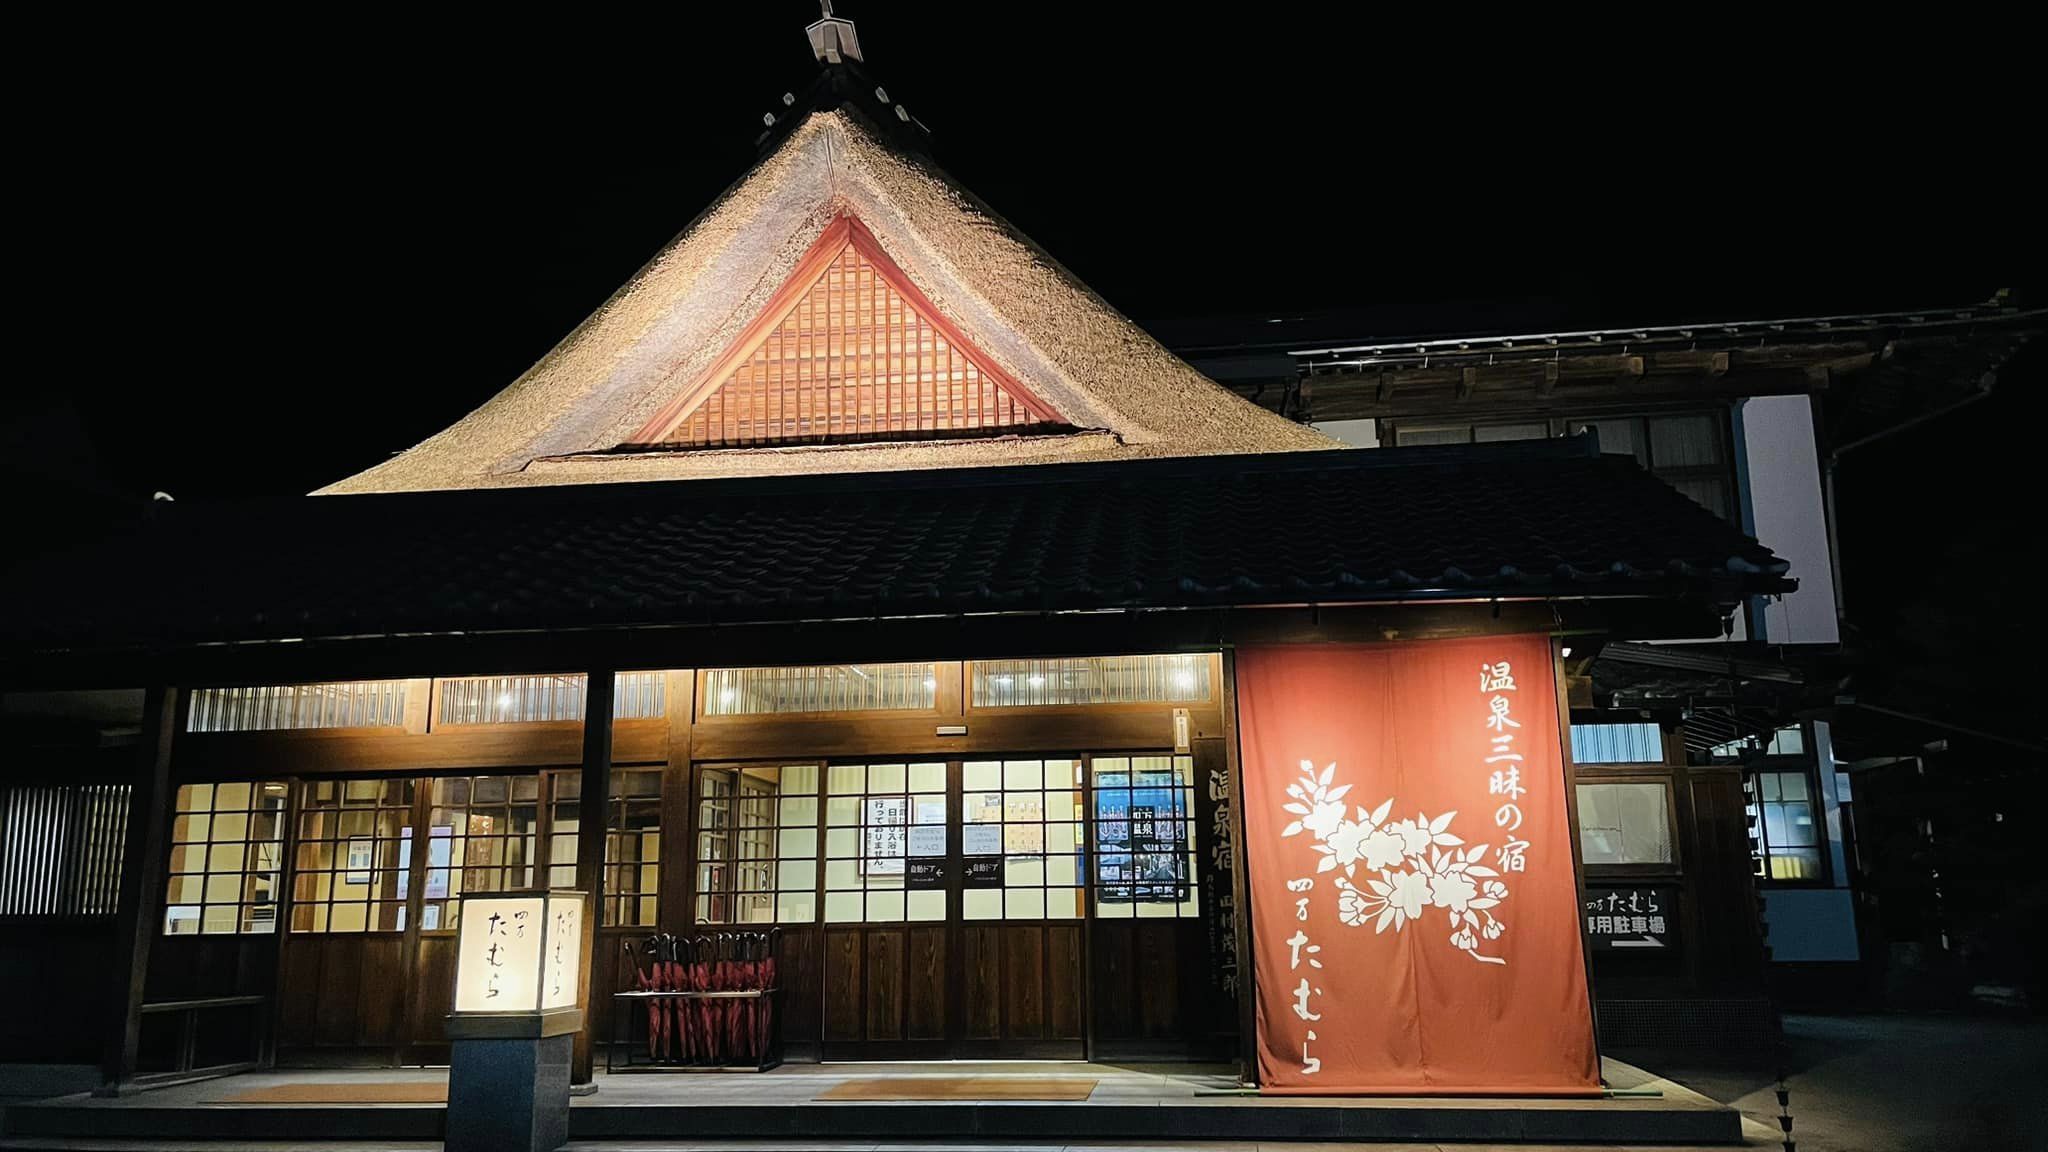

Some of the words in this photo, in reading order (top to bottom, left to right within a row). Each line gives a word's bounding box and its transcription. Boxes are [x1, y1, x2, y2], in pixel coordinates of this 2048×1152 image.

[1480, 661, 1530, 873] 温泉三昧の宿
[910, 865, 936, 873] 自動ドア
[486, 912, 507, 998] たむら
